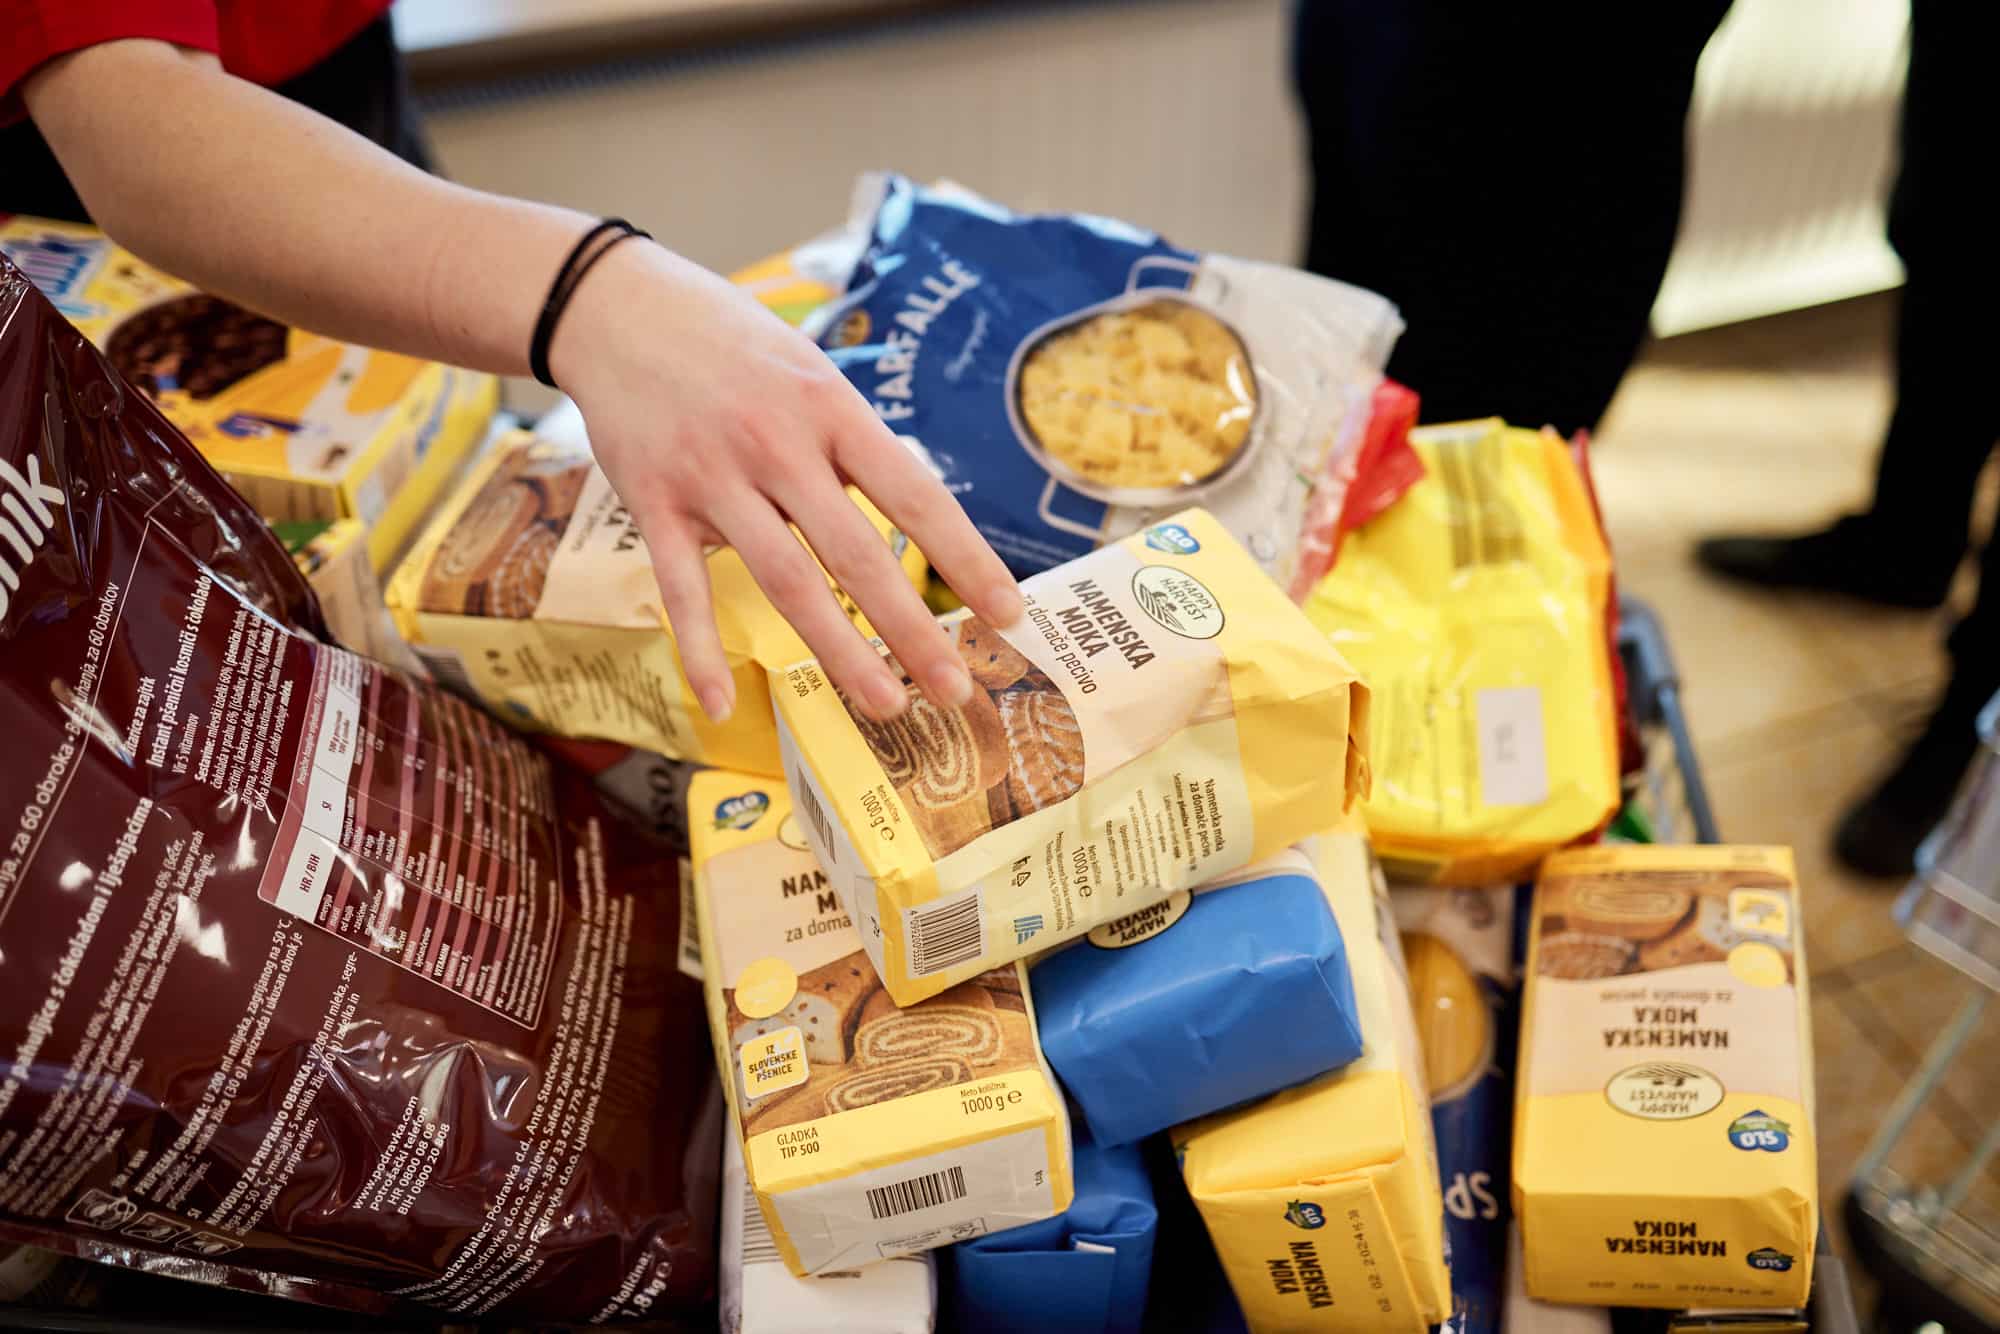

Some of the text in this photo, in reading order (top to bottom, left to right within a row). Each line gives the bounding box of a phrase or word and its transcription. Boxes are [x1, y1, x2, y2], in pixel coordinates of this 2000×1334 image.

[882, 261, 980, 421] FARFALLE
[184, 573, 212, 624] čokolado
[1159, 574, 1206, 624] HARVEST
[1177, 576, 1213, 612] HAPPY
[1055, 601, 1109, 659] MOKA
[1068, 574, 1155, 670] NAMENSKA
[169, 629, 197, 675] kosmiči
[1027, 603, 1072, 654] domače
[1056, 649, 1100, 697] pecivo
[134, 675, 158, 719] za zajtrk
[157, 673, 188, 724] pšenični
[793, 680, 810, 698] 500
[10, 580, 120, 855] za 60 obroka za 60 obrokov
[194, 665, 233, 782] Sestavine: mlevski izdelki 60%
[146, 721, 172, 767] Instant
[172, 712, 200, 774] Vir vitaminov
[210, 709, 239, 789] čokolada 6%
[859, 789, 884, 818] 1000
[1189, 781, 1199, 792] za
[1204, 777, 1221, 827] Namenska
[99, 794, 156, 889] lješnjacima
[1069, 845, 1089, 875] 1000
[153, 868, 172, 889] 6%
[298, 853, 320, 892] HR BIH
[51, 892, 109, 987] čokoladom
[784, 916, 852, 943] za doma
[1107, 904, 1171, 936] HARVEST
[1119, 915, 1166, 945] HAPPY
[49, 983, 65, 999] s
[347, 991, 360, 1004] in
[209, 931, 305, 1123] žlica (30 g) proizvoda ukusan obrok je
[1633, 1007, 1696, 1023] MOKA
[766, 1044, 775, 1055] IZ
[1602, 1029, 1728, 1048] NAMENSKA
[134, 929, 286, 1195] PRIPREMA OBROKA: U 200 ml mlijeka, zagrijanog na 50
[308, 1068, 327, 1089] žlic
[748, 1050, 799, 1074] SLOVENSKE
[756, 1064, 793, 1084] PŠENICE
[206, 949, 360, 1227] NAVODILO ZA PRIPRAVO OBROKA: 200 ml mleka, segre-
[290, 1086, 318, 1123] velikih
[962, 1096, 1005, 1115] 1000 g
[287, 1120, 300, 1130] 5
[485, 1161, 521, 1221] Podravka
[512, 1133, 534, 1164] d.d.,
[525, 1103, 545, 1134] Ante
[536, 1041, 565, 1102] Starčevića
[558, 1151, 580, 1186] d.o.o.
[570, 1092, 602, 1151] Ljubljana,
[777, 1128, 818, 1147] GLADKA
[1739, 1130, 1778, 1147] SLO
[257, 1112, 321, 1212] obrok je pripravljen.
[260, 1127, 296, 1177] vmešajte
[351, 1094, 421, 1212] www.podravka.com
[369, 1104, 430, 1211] potrošački telefon
[387, 1121, 436, 1206] HR 0800 08 08
[466, 1225, 509, 1277] Podravka
[501, 1192, 527, 1228] d.o.o.
[517, 1135, 553, 1194] Sarajevo,
[542, 1097, 566, 1136] Safeta
[556, 1062, 577, 1097] Zajke
[780, 1141, 820, 1160] TIP 500
[244, 1187, 261, 1203] 50
[396, 1193, 416, 1216] BIH
[410, 1163, 432, 1194] 0800
[426, 1146, 441, 1164] 20
[496, 1084, 586, 1265] 760, telefaks: +387 33 475 779,
[237, 1202, 250, 1215] na
[1301, 1207, 1321, 1224] SLO
[1633, 1220, 1696, 1237] MOKA
[1604, 1238, 1726, 1256] NAMENSKA
[1266, 1259, 1299, 1295] MOKA
[1289, 1241, 1334, 1309] NAMENSKA
